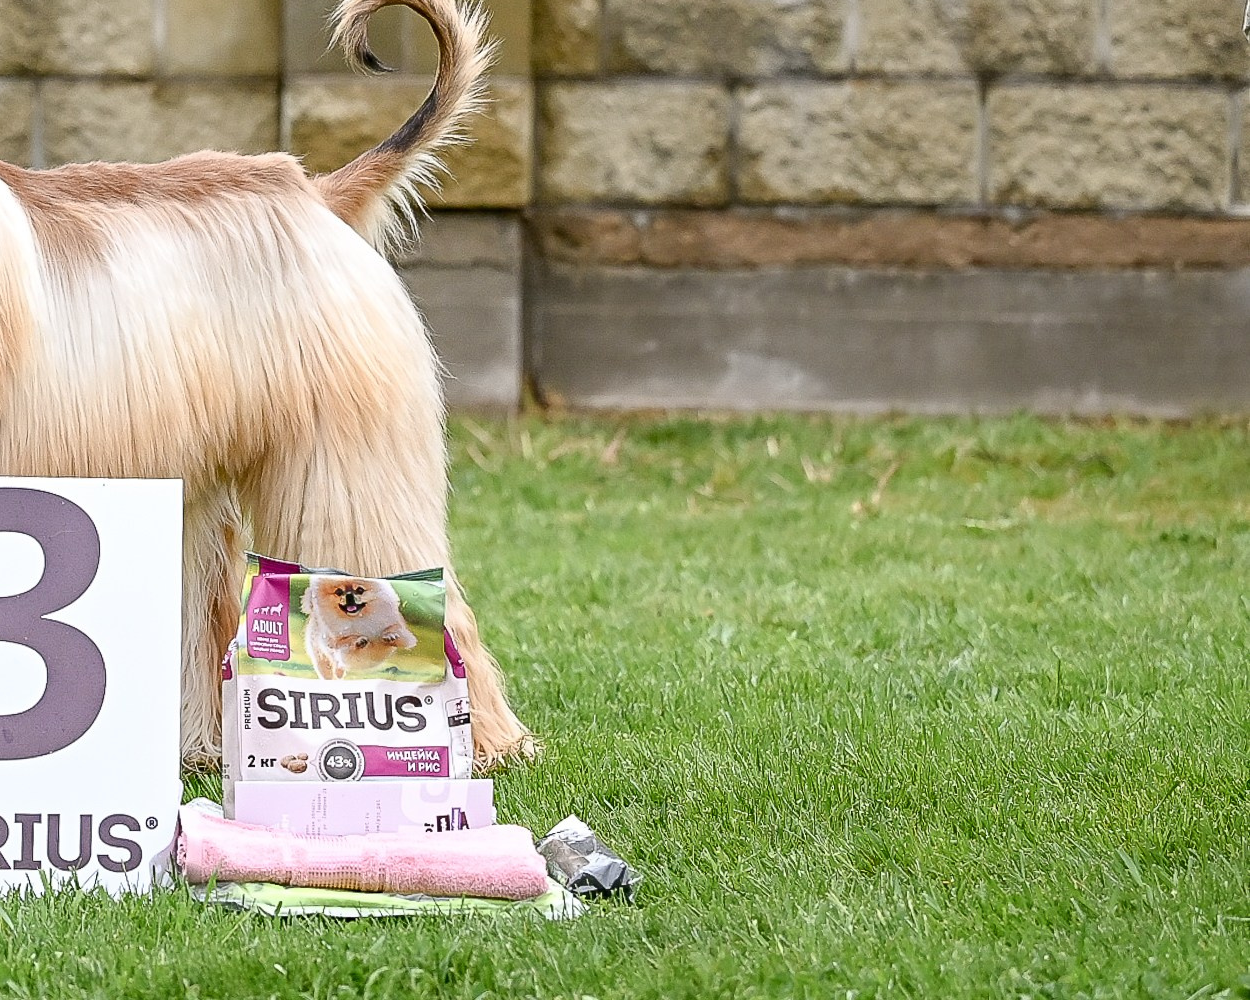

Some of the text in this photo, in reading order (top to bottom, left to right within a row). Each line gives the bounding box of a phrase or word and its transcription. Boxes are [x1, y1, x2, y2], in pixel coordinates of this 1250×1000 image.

[252, 619, 284, 636] ADULT
[247, 755, 256, 768] 2
[326, 755, 354, 769] 43%
[386, 748, 440, 762] ИНДЕЙКА
[407, 762, 441, 773] И РИС
